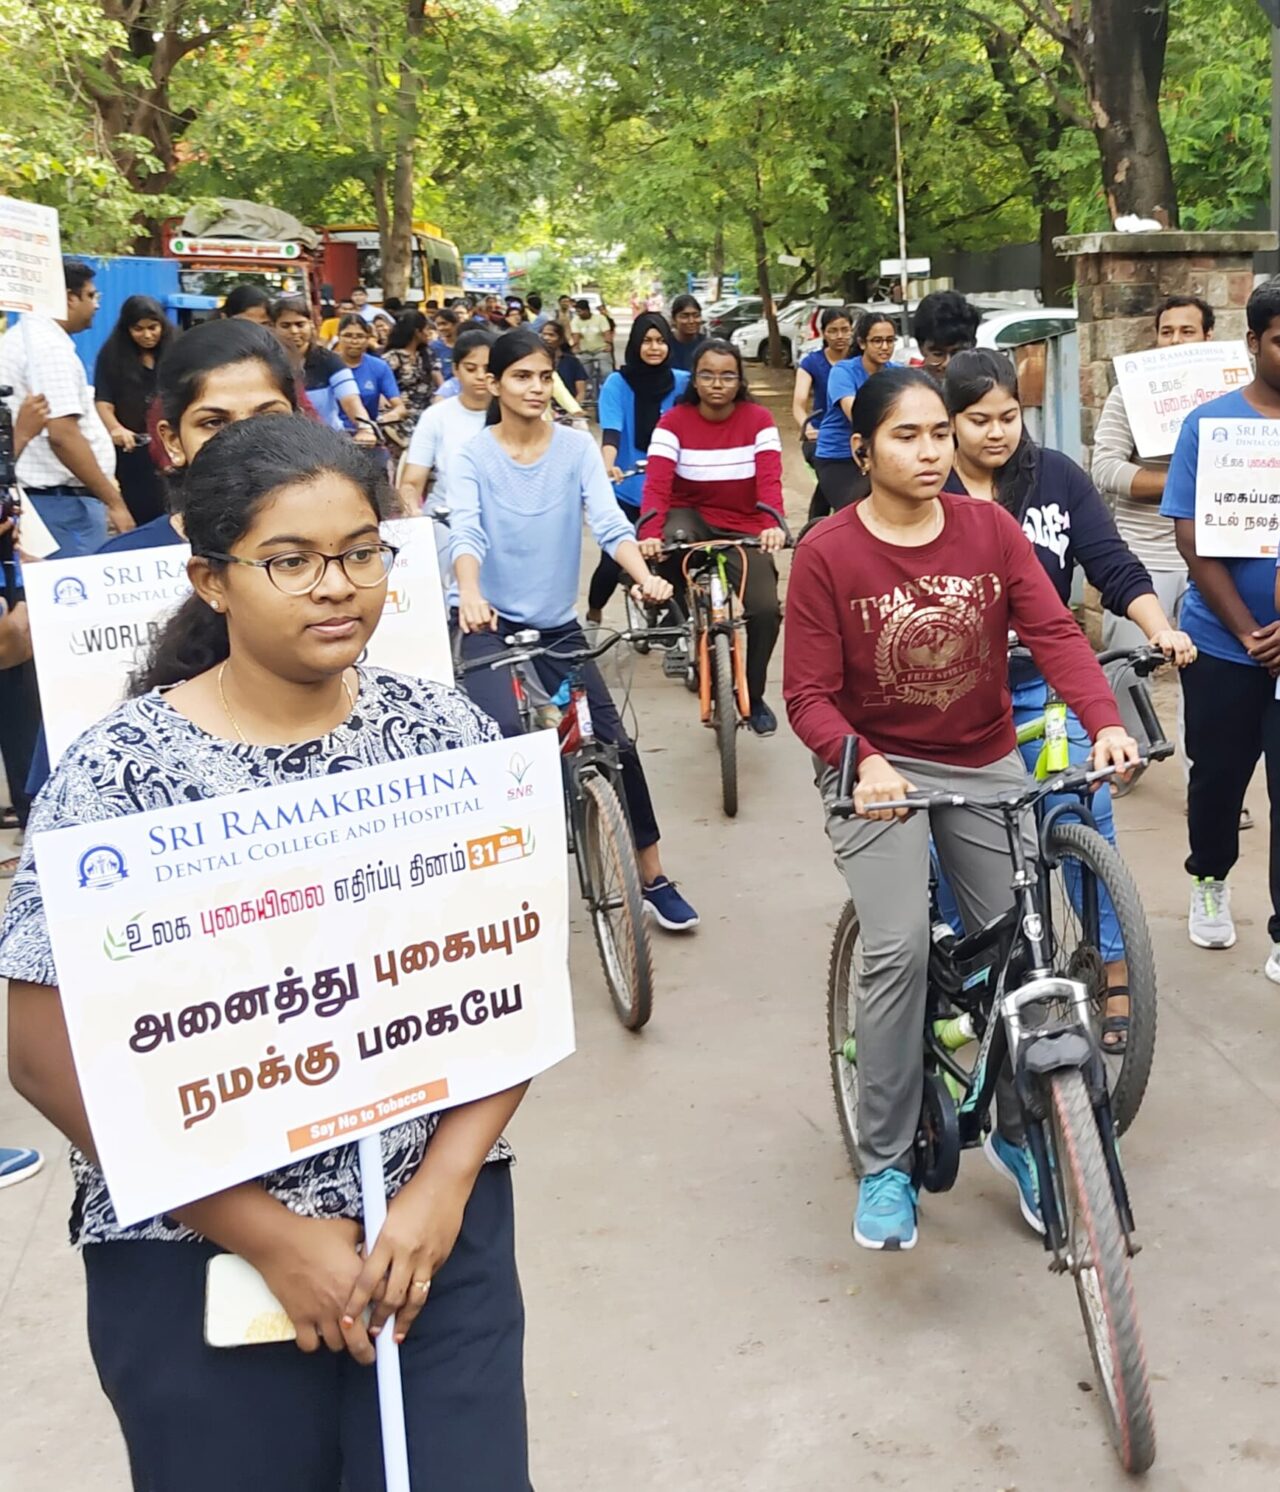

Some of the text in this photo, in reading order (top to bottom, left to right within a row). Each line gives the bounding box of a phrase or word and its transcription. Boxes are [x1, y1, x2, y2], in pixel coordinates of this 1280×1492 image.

[1154, 388, 1228, 416] புகையி
[1236, 425, 1256, 437] SRI
[1204, 512, 1239, 527] உடல்
[103, 565, 144, 587] SRI
[107, 588, 170, 607] DENTAL
[850, 572, 1002, 634] TRANSCEND
[148, 765, 480, 856] SRI RAMAKRISHNA
[154, 797, 485, 883] DENTAL COLLEGE AND HOSPITAL
[126, 915, 192, 953] உலக
[200, 884, 325, 938] புகையிலை
[333, 860, 402, 904] எதிர்ப்பு
[409, 842, 467, 888] தினம்
[470, 840, 496, 866] 31
[128, 900, 542, 1054] அனைத்து புகையும்
[176, 983, 524, 1131] நமக்கு பகையே
[310, 1089, 427, 1140] Say No to Tobacco
